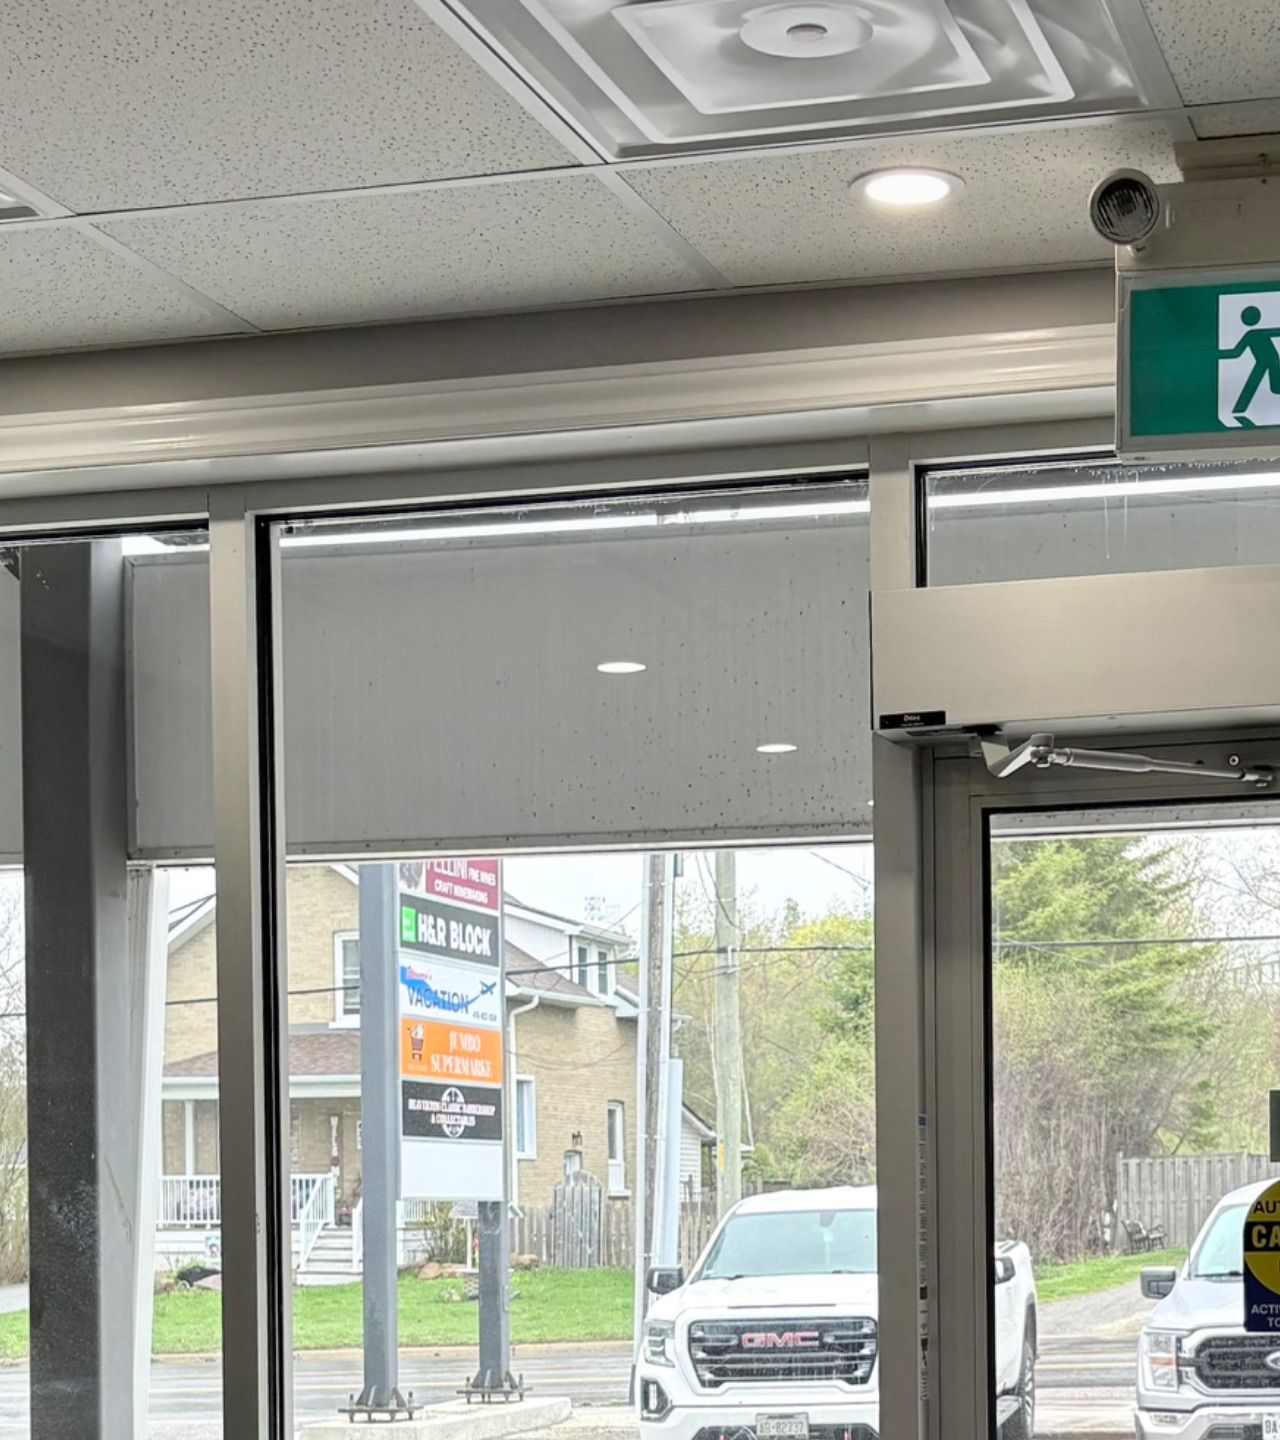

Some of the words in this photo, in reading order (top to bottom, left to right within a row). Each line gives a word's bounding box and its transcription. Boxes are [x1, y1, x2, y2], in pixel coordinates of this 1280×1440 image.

[418, 912, 447, 948] H&R
[449, 920, 491, 956] BLOCK
[407, 985, 469, 1015] VACATION
[449, 1031, 481, 1053] JUMBO
[742, 1331, 819, 1348] GMC
